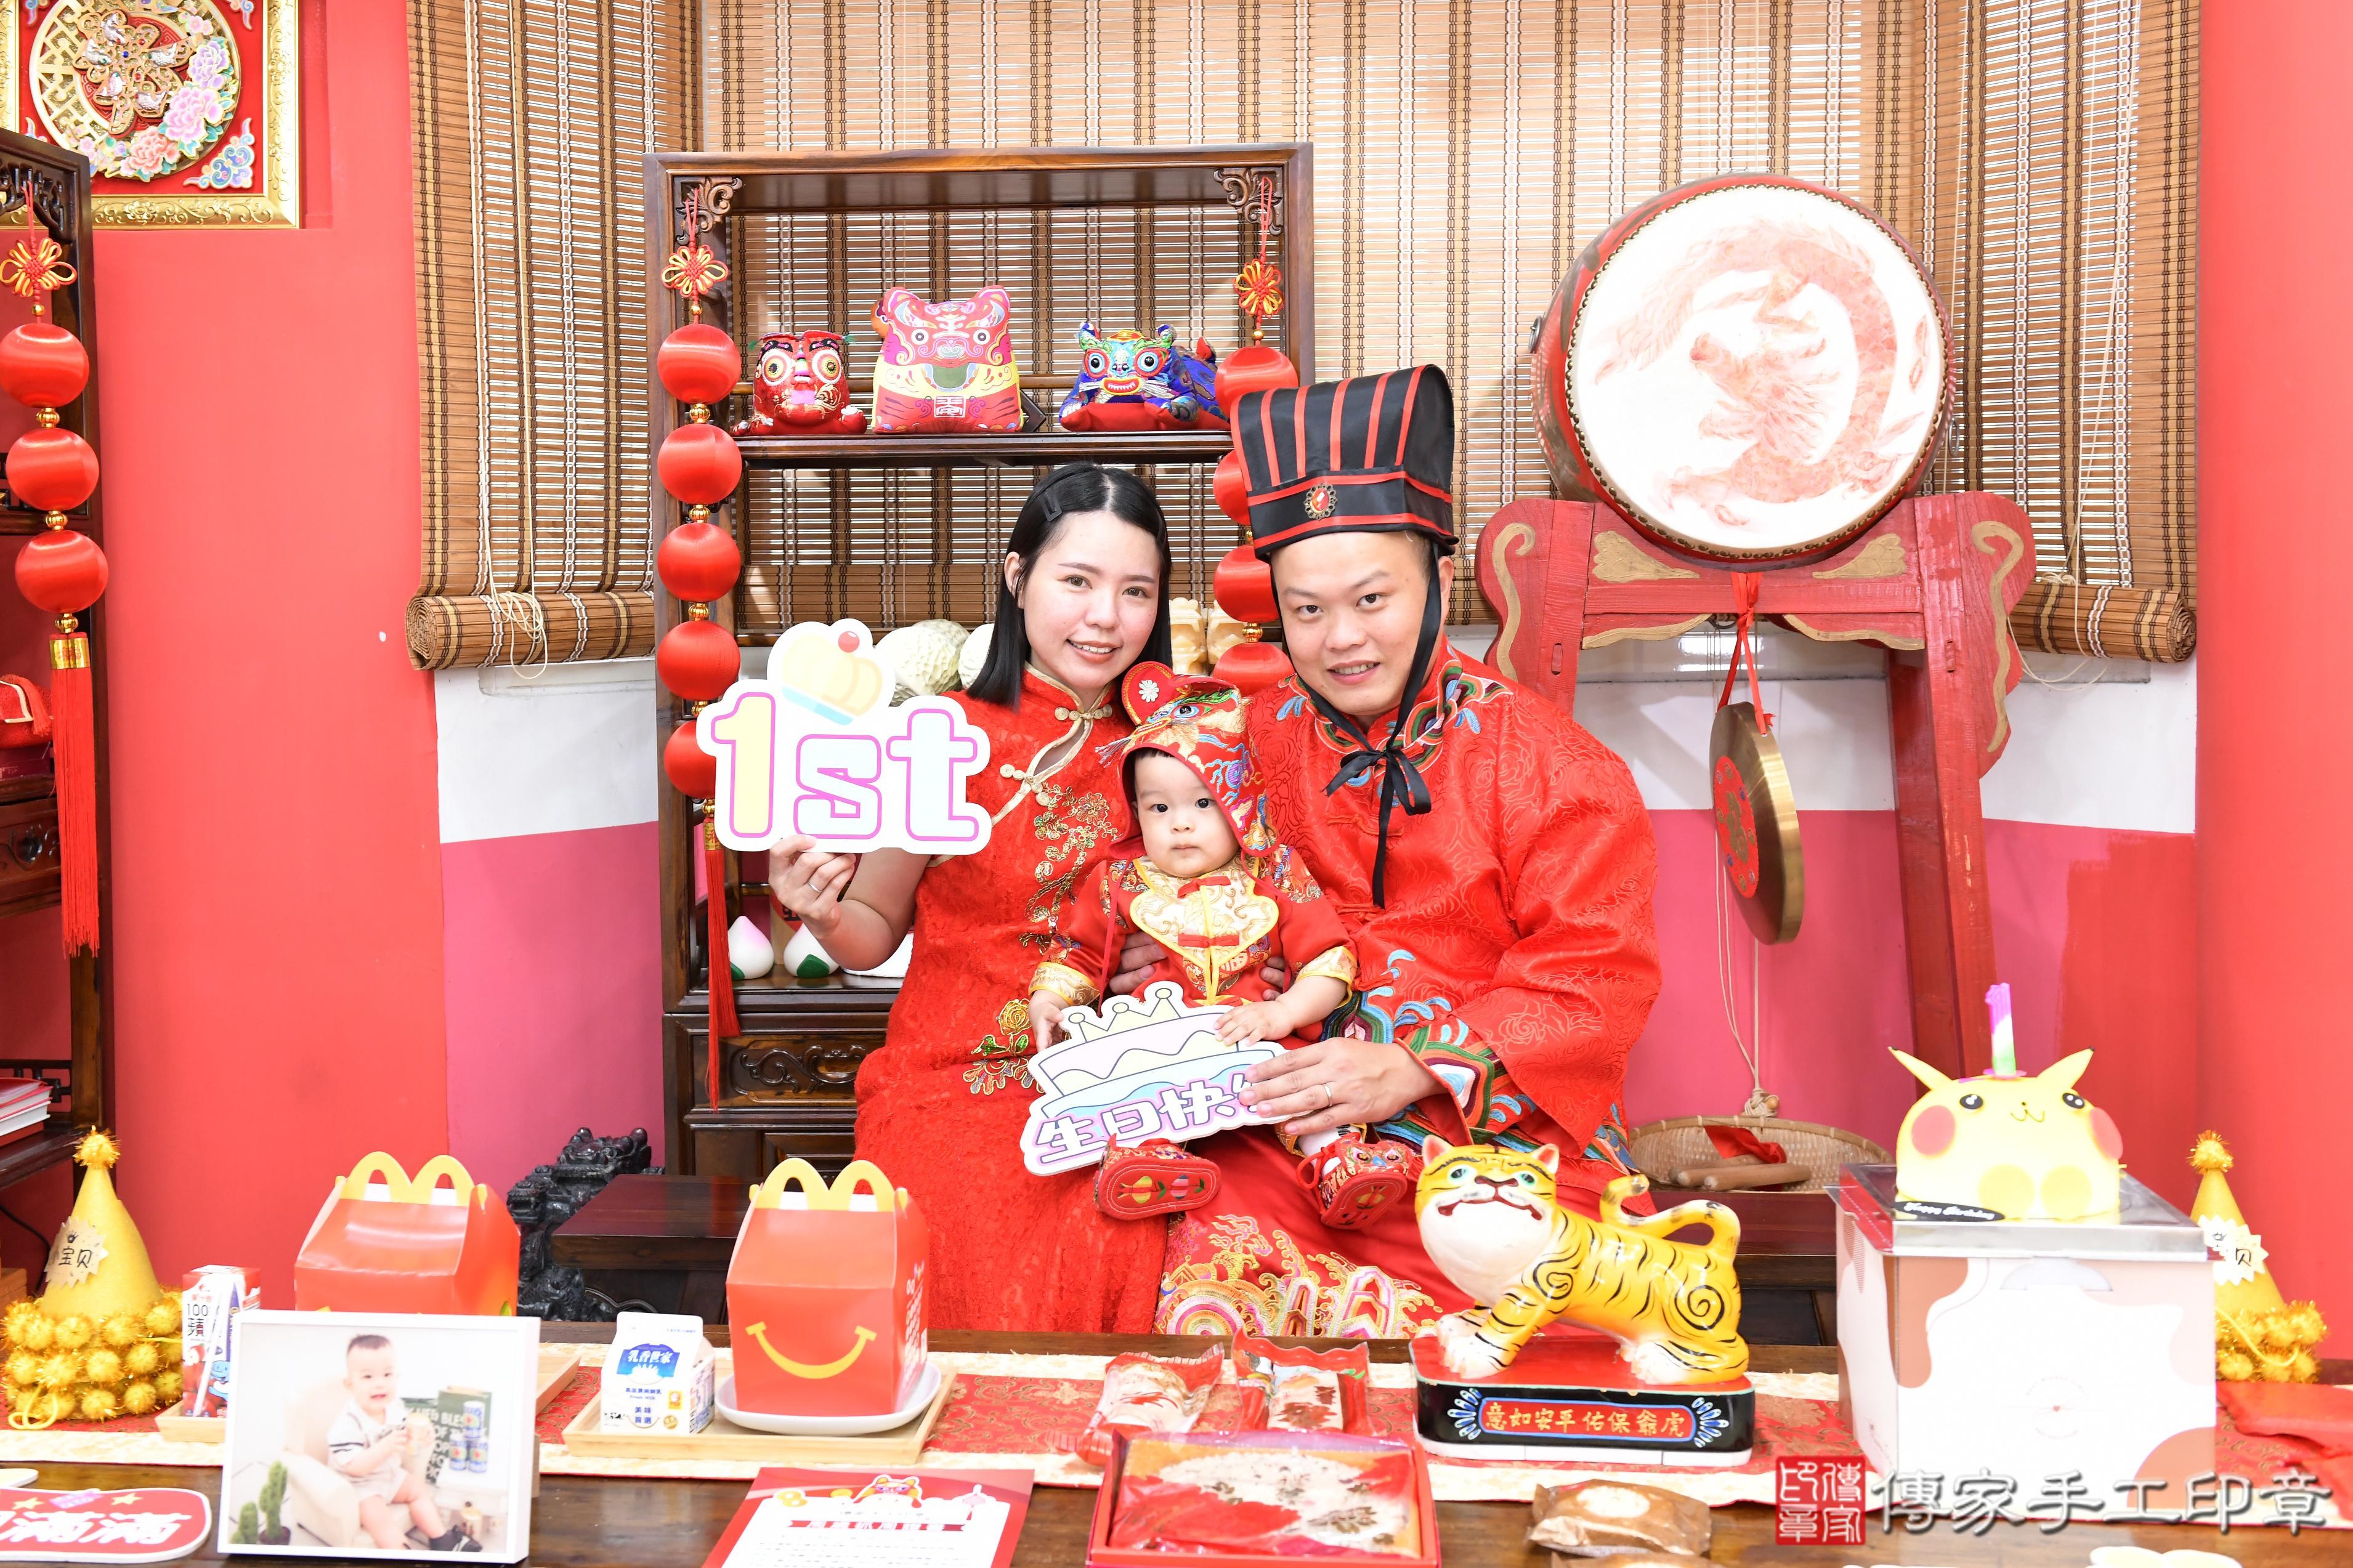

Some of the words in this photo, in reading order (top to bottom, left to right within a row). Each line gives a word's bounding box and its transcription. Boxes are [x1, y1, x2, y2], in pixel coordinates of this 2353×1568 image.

[711, 692, 979, 842] 1st
[1943, 1206, 1995, 1220] Birthday
[627, 1349, 673, 1364] 乳香世家
